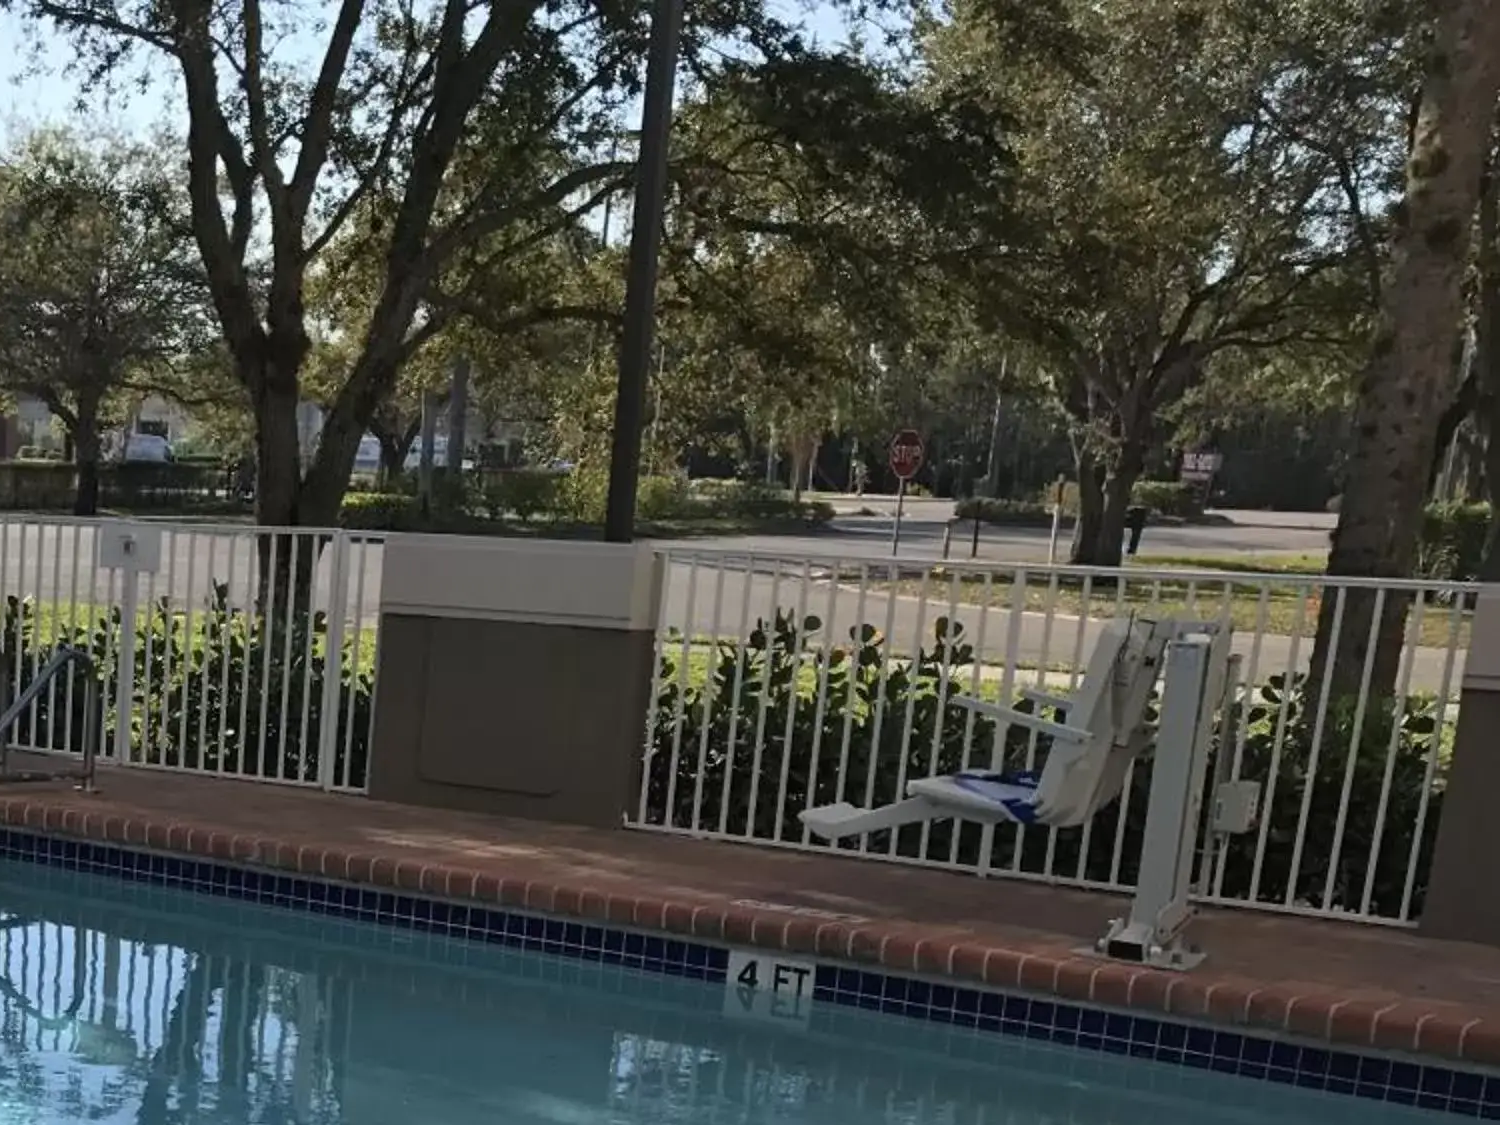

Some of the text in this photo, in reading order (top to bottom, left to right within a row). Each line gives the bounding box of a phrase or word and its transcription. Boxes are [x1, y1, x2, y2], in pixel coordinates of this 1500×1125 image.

[893, 445, 921, 464] STOP
[737, 960, 811, 994] 4 FT
